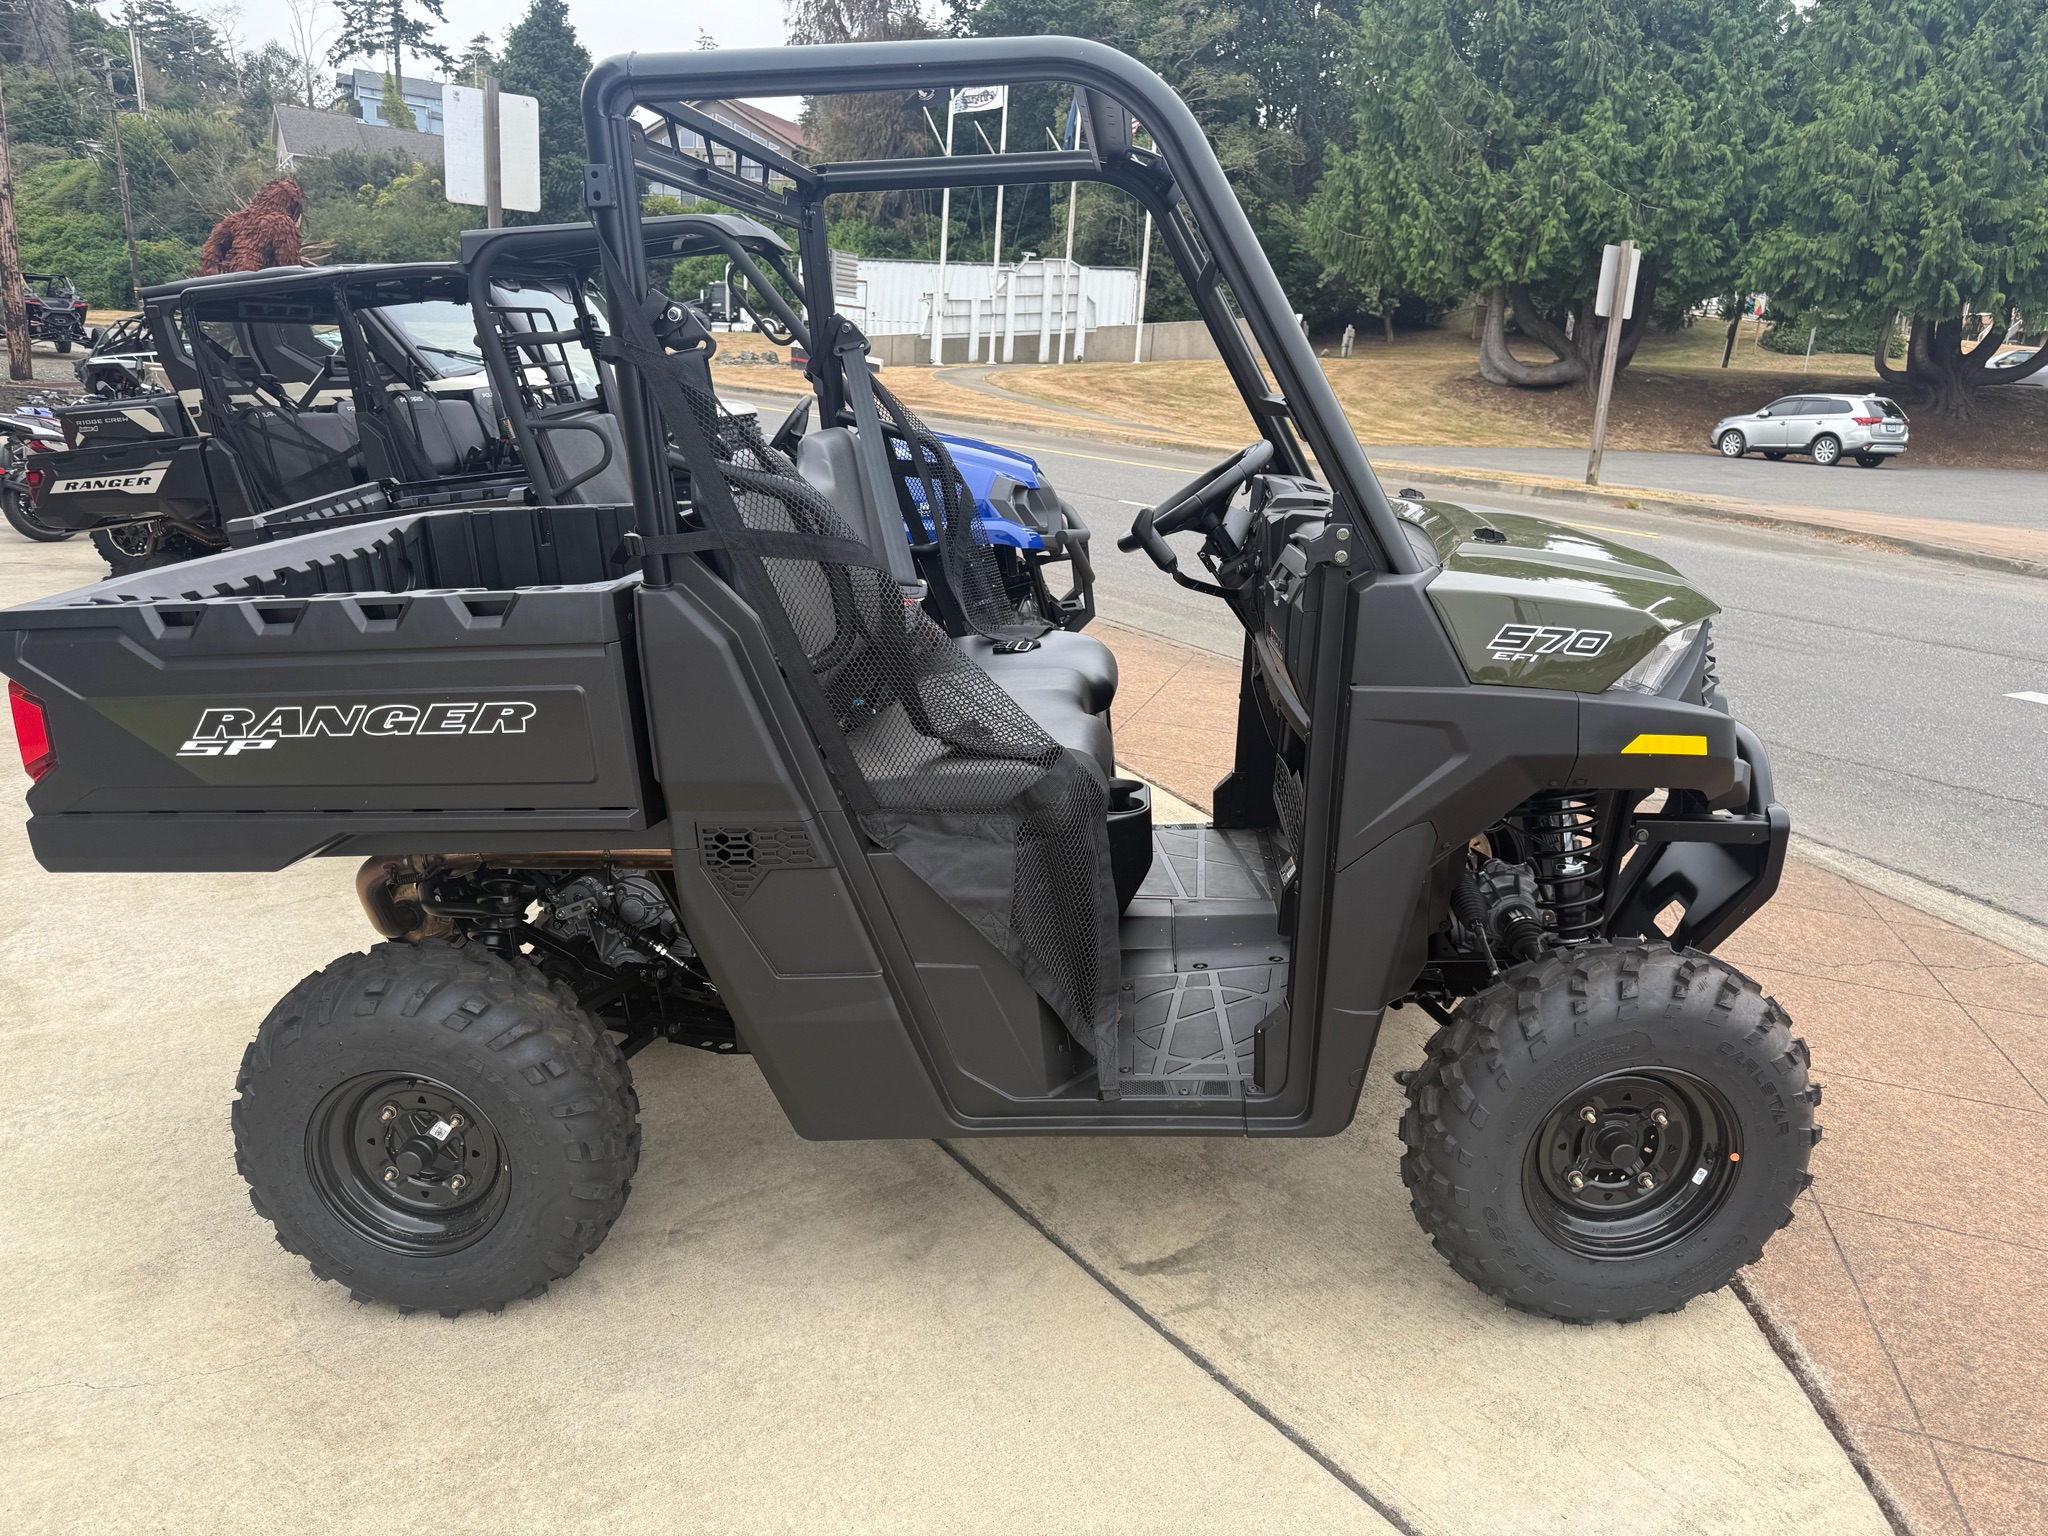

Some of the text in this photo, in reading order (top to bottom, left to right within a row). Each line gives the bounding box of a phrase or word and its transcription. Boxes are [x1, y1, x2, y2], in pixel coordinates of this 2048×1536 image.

[64, 476, 152, 491] RANGER
[1486, 623, 1612, 656] 570
[1492, 651, 1540, 663] EFI
[193, 702, 537, 739] RANGER
[175, 739, 278, 757] SP
